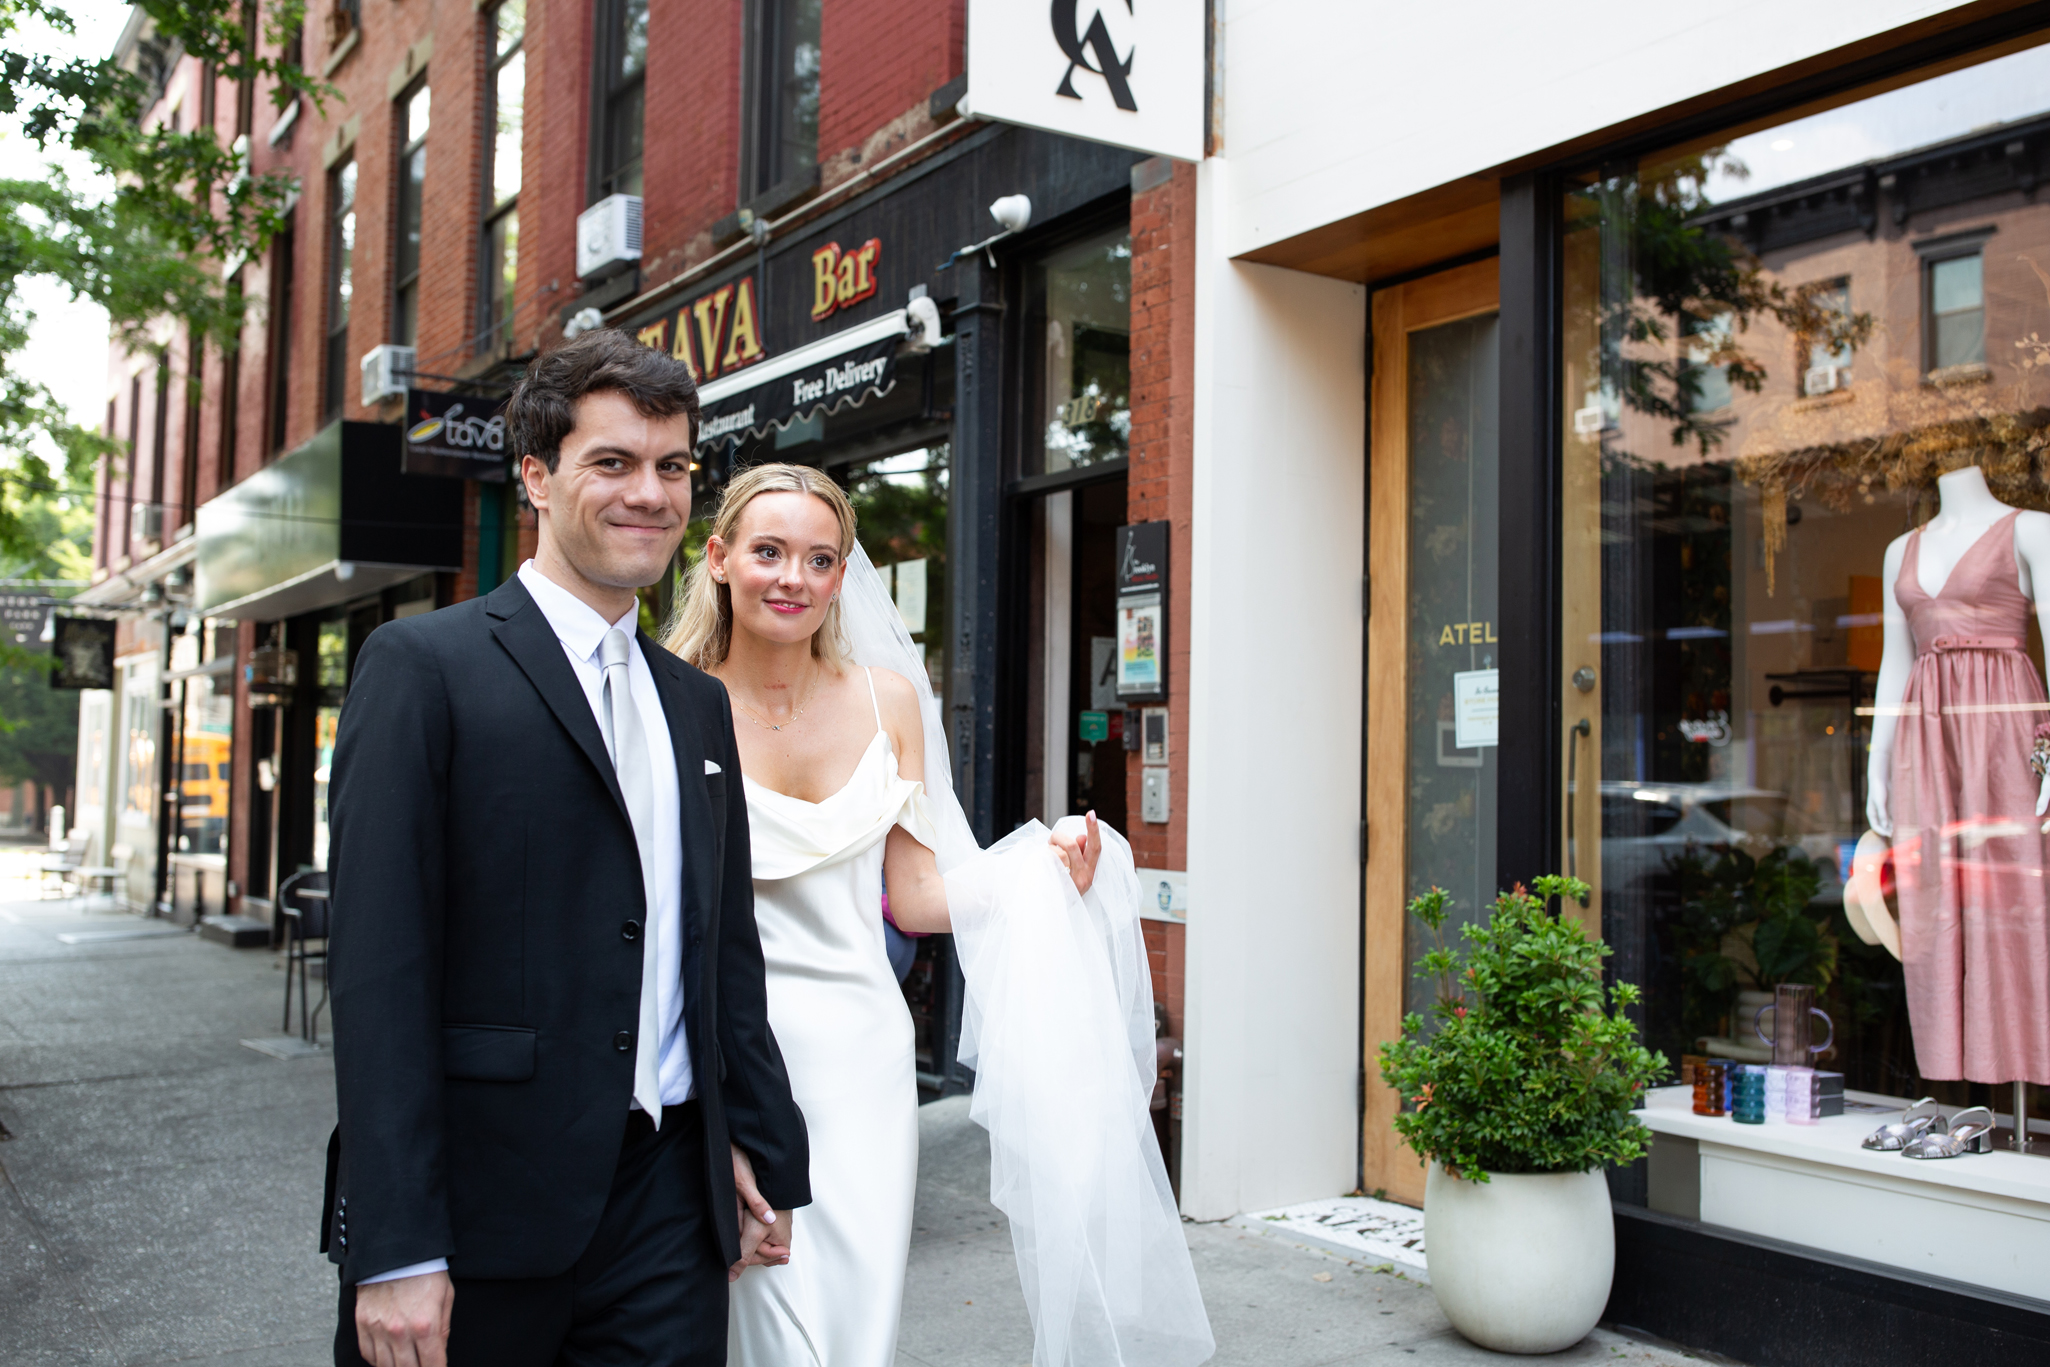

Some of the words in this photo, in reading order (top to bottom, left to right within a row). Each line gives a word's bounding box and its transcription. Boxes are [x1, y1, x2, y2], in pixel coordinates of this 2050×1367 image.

[811, 237, 881, 323] Bar
[792, 378, 825, 407] Free
[825, 356, 888, 396] Delivery
[443, 402, 507, 451] tava
[1063, 396, 1097, 425] 318
[1439, 621, 1498, 646] ATEL
